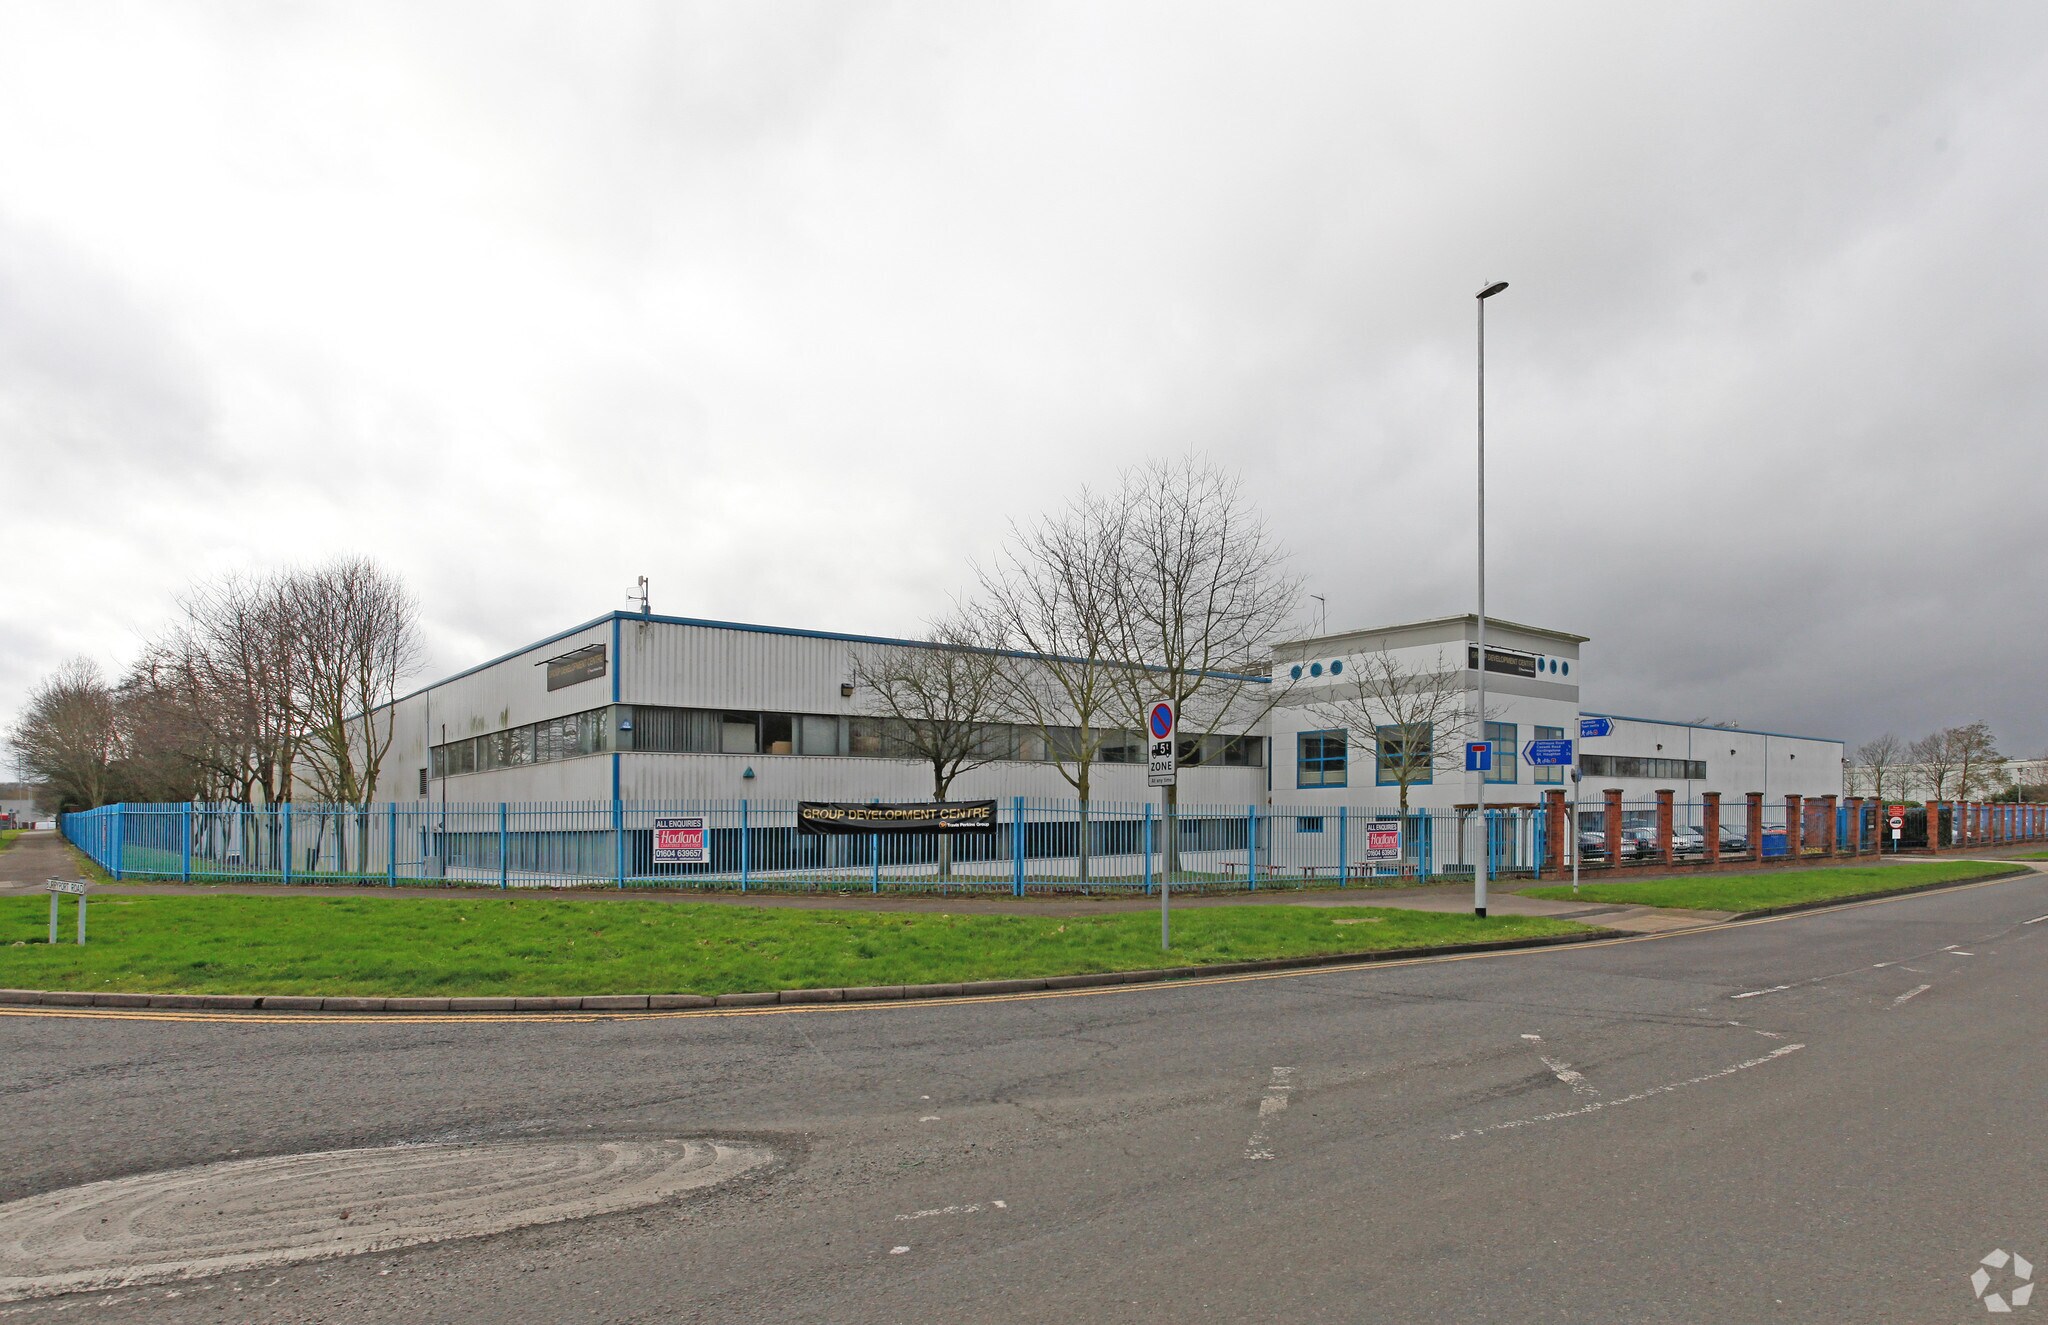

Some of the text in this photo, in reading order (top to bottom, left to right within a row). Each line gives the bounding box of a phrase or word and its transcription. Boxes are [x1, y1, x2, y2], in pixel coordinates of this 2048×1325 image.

[1488, 654, 1518, 665] DEVELOPMENT
[1151, 761, 1172, 771] ZONE
[803, 807, 990, 820] GROUP DEVELOPMENT CENTRE
[660, 830, 702, 844] Hadland
[1370, 833, 1397, 845] Hadland
[677, 849, 702, 857] 639657
[70, 883, 84, 894] ROAD
